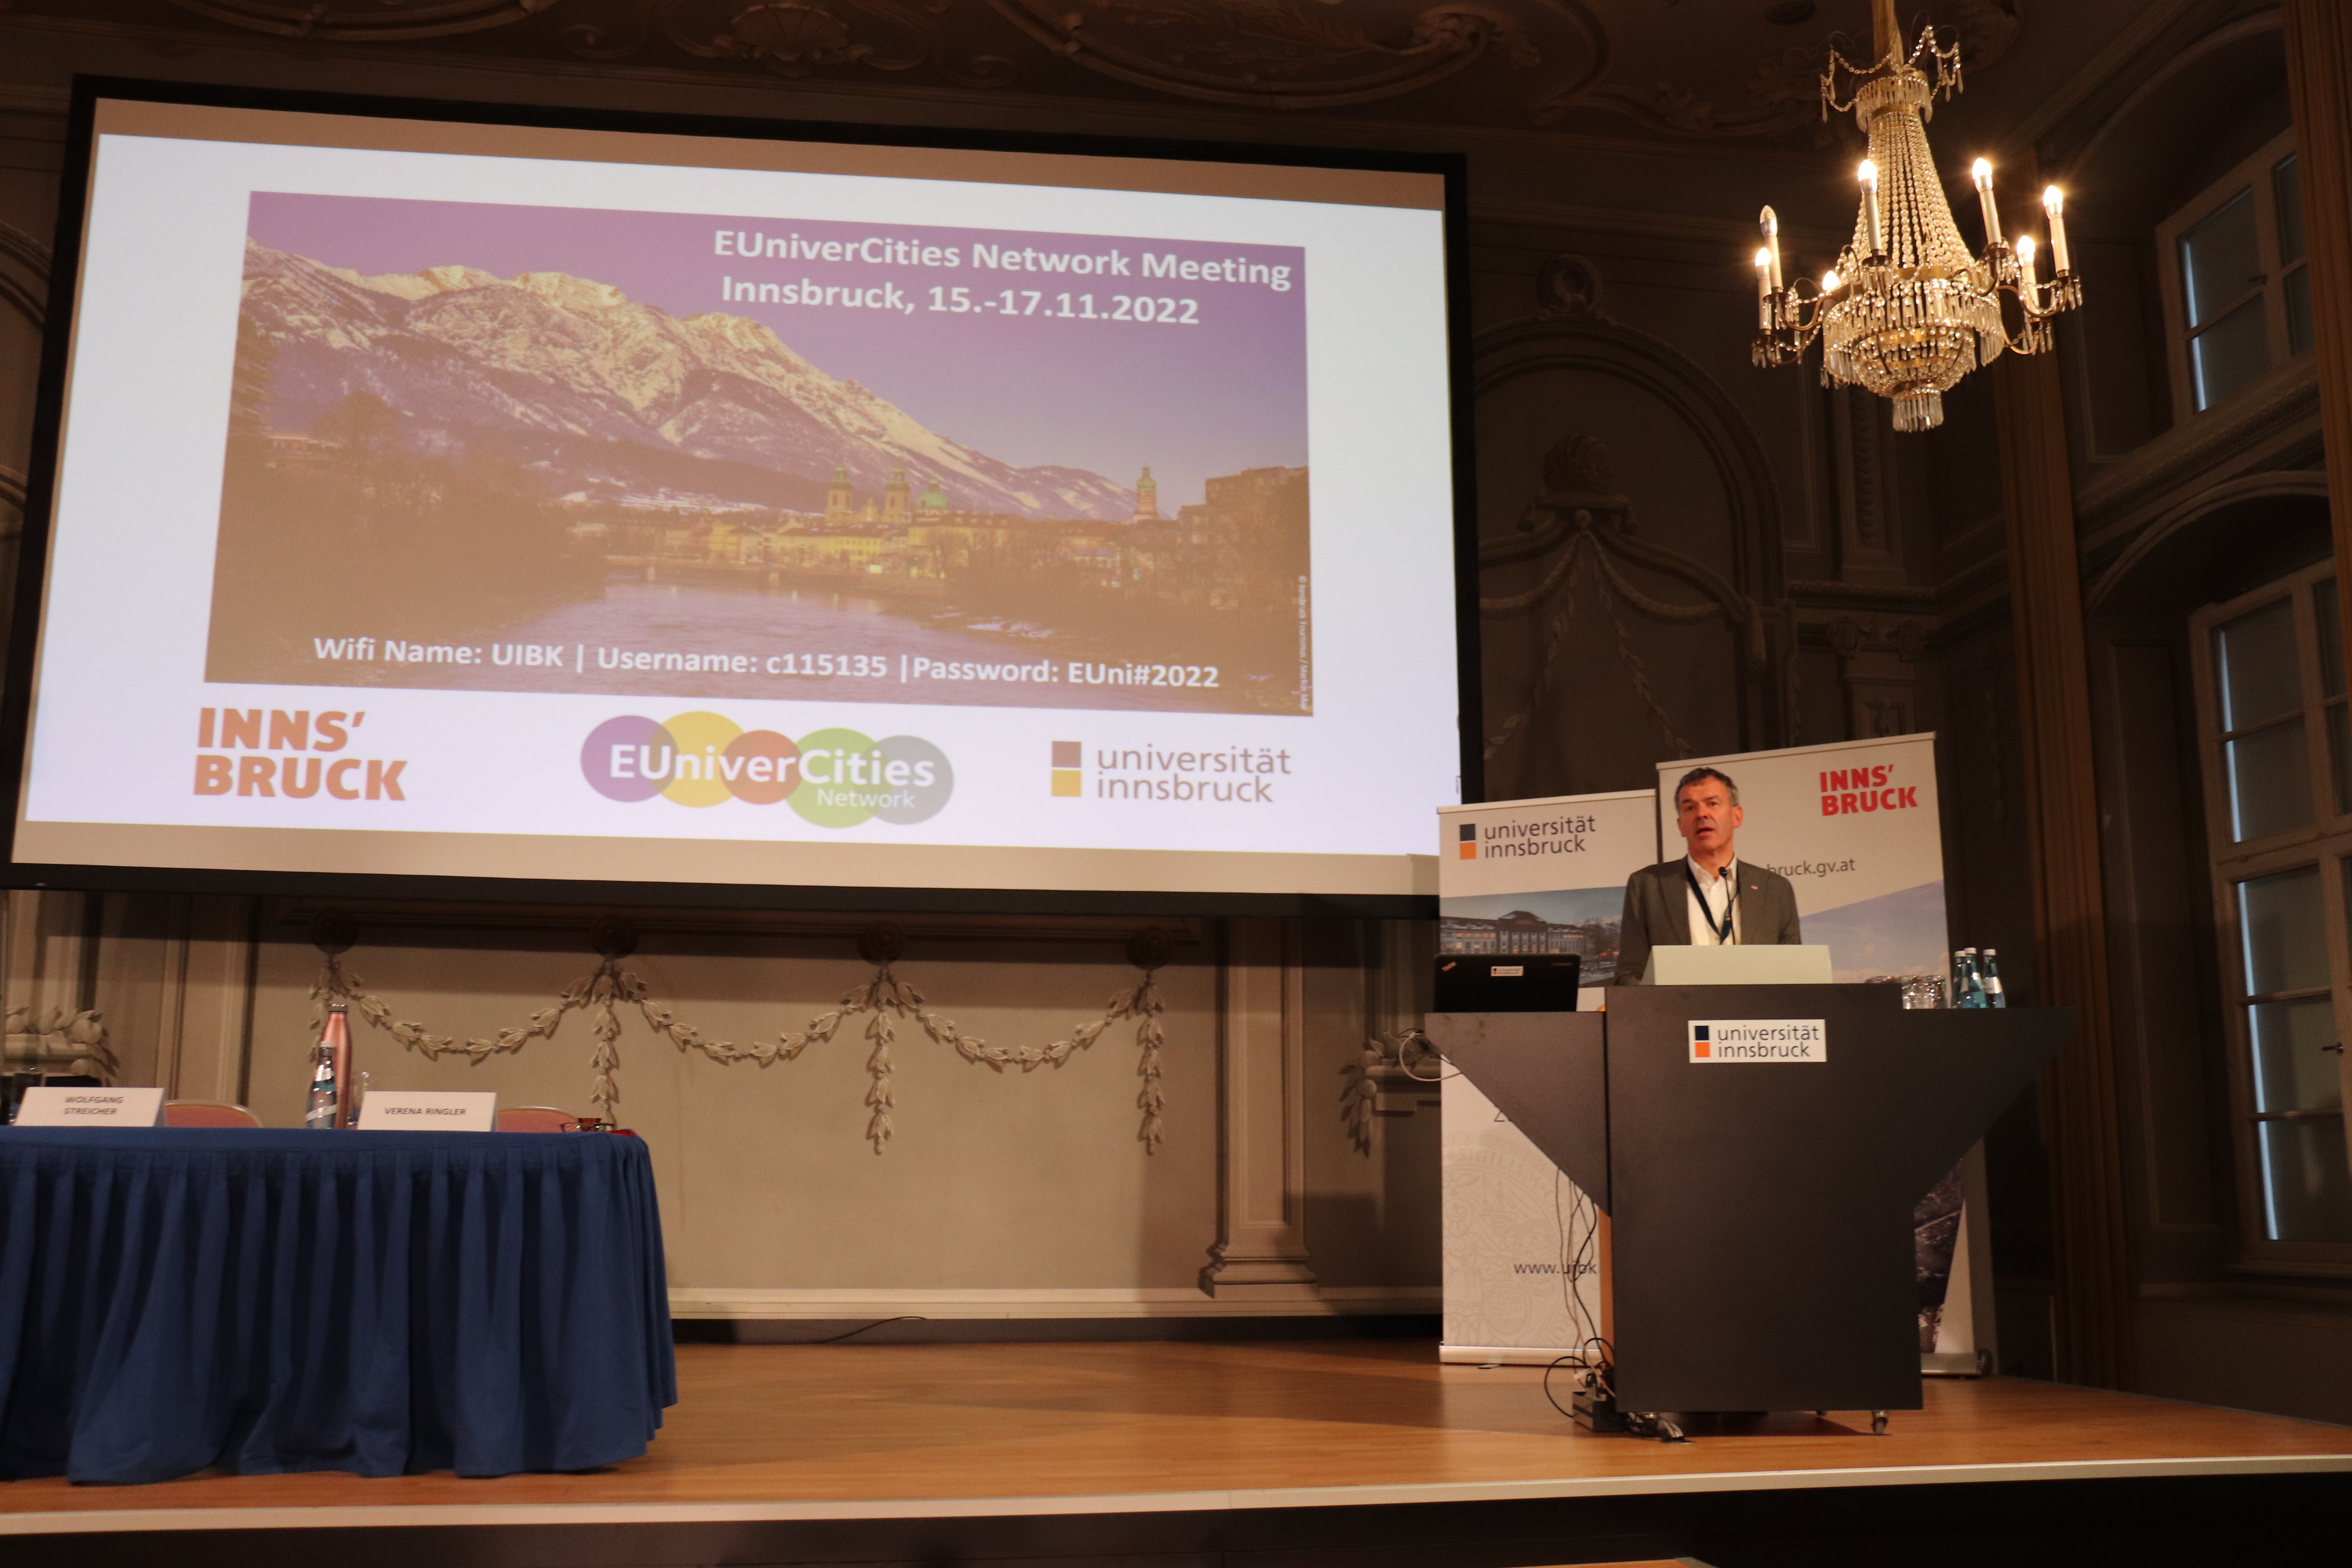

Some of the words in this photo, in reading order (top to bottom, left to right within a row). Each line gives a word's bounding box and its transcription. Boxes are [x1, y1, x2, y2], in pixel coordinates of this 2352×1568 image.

[714, 230, 961, 268] EUniverCities
[973, 242, 1131, 276] Network
[1142, 251, 1292, 292] Meeting
[722, 276, 915, 315] Innsbruck,
[928, 286, 1200, 325] 15.-17.11.2022
[314, 637, 375, 660] Wifi
[385, 640, 481, 664] Name:
[493, 644, 563, 667] UIBK
[598, 647, 757, 673] Username:
[766, 653, 887, 678] c115135
[1068, 662, 1219, 688] EUni#2022
[610, 743, 935, 788] EUniverCities
[1098, 743, 1291, 774] universität
[194, 755, 407, 800] BRUCK
[1098, 771, 1274, 802] innsbruck
[817, 789, 915, 809] Network
[1822, 786, 1918, 816] BRUCK
[1485, 815, 1596, 840] universität
[1485, 835, 1585, 858] innsbruck
[1718, 1025, 1819, 1041] universität
[1719, 1042, 1811, 1058] innsbruck
